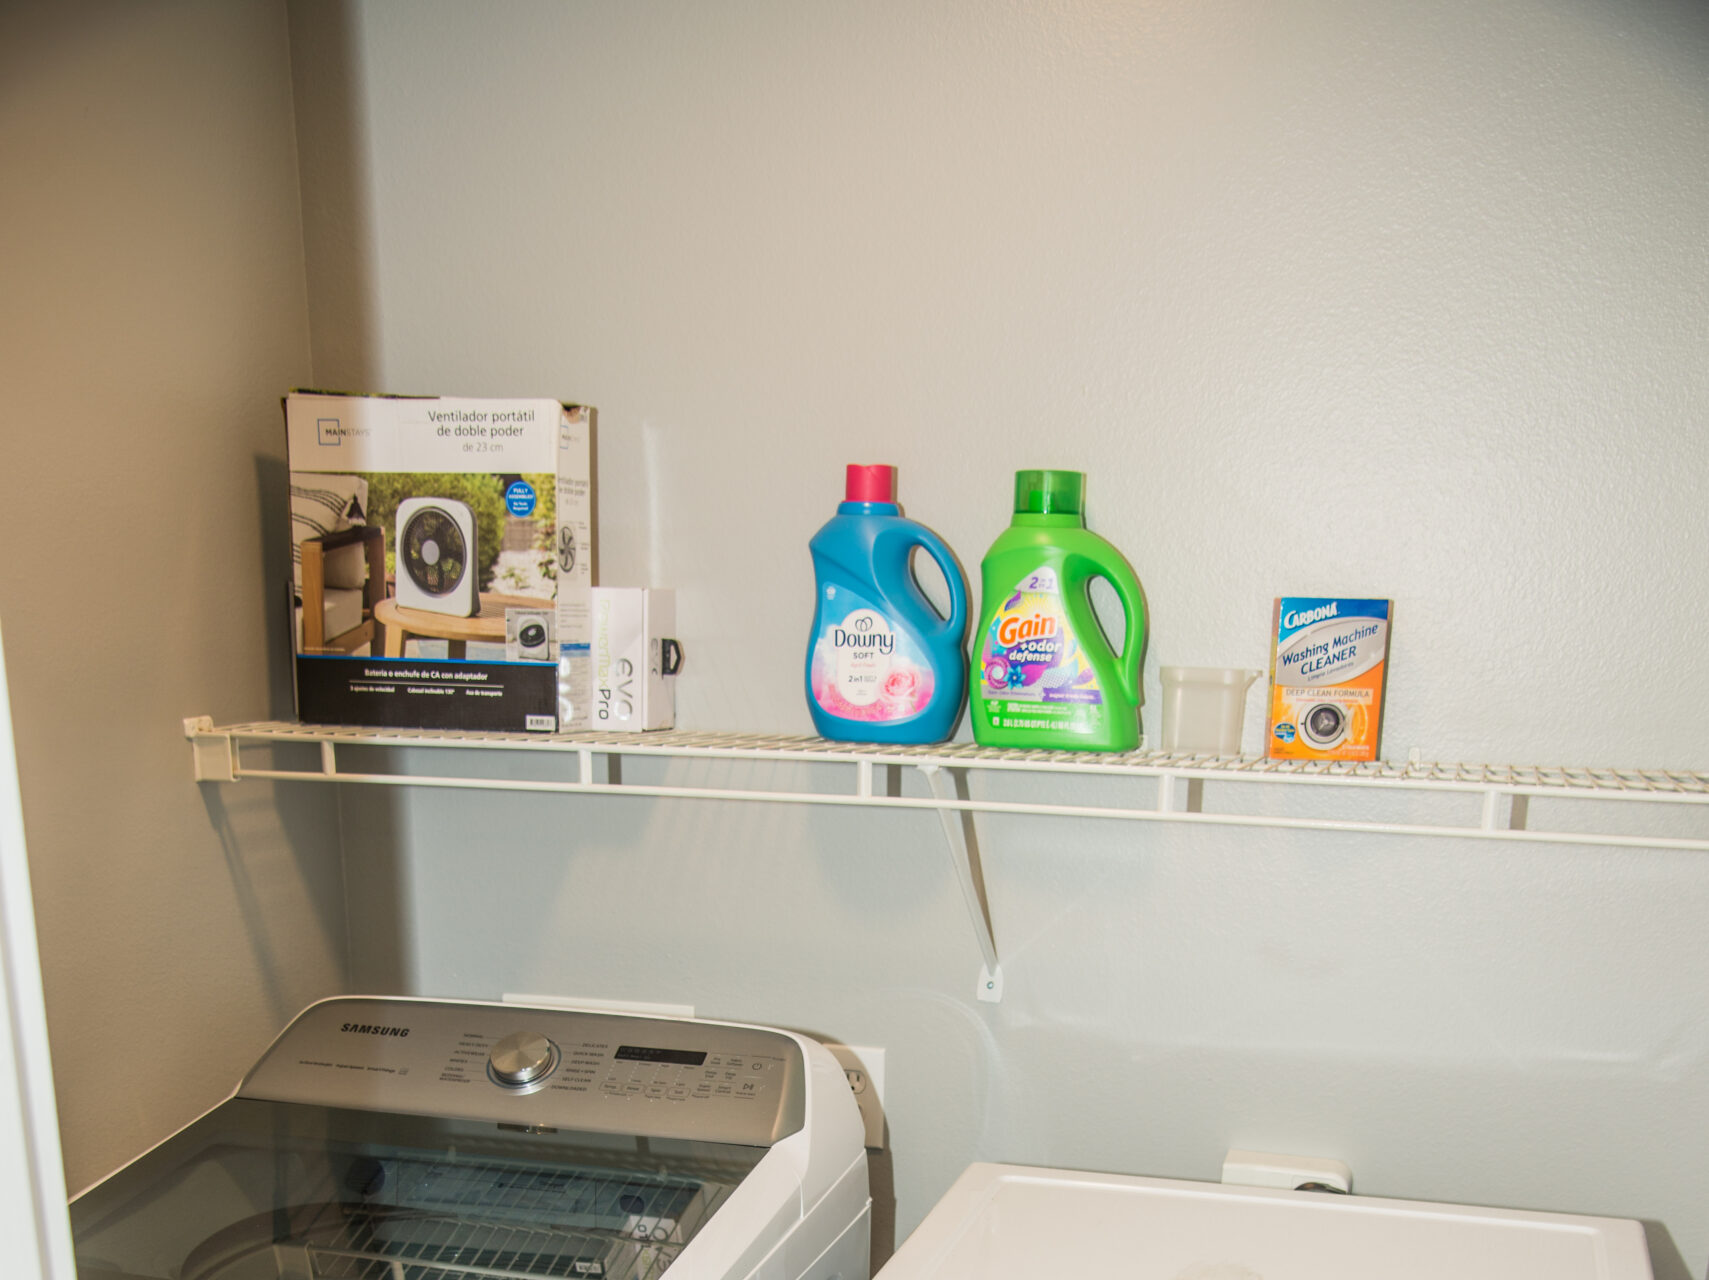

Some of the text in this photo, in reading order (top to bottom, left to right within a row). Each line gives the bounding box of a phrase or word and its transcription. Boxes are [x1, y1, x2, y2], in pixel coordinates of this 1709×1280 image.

[428, 410, 535, 425] Ventilador portátil
[437, 425, 524, 440] de doble poder
[462, 442, 504, 452] de 23 cm
[999, 613, 1056, 646] Gain
[834, 629, 894, 655] Downy
[1282, 624, 1378, 667] Washing Machine
[853, 652, 874, 660] SOFT
[1008, 650, 1053, 662] defense
[1300, 646, 1357, 675] CLEANER
[1286, 688, 1305, 696] DEEP
[340, 1023, 410, 1038] SAMSUNG
